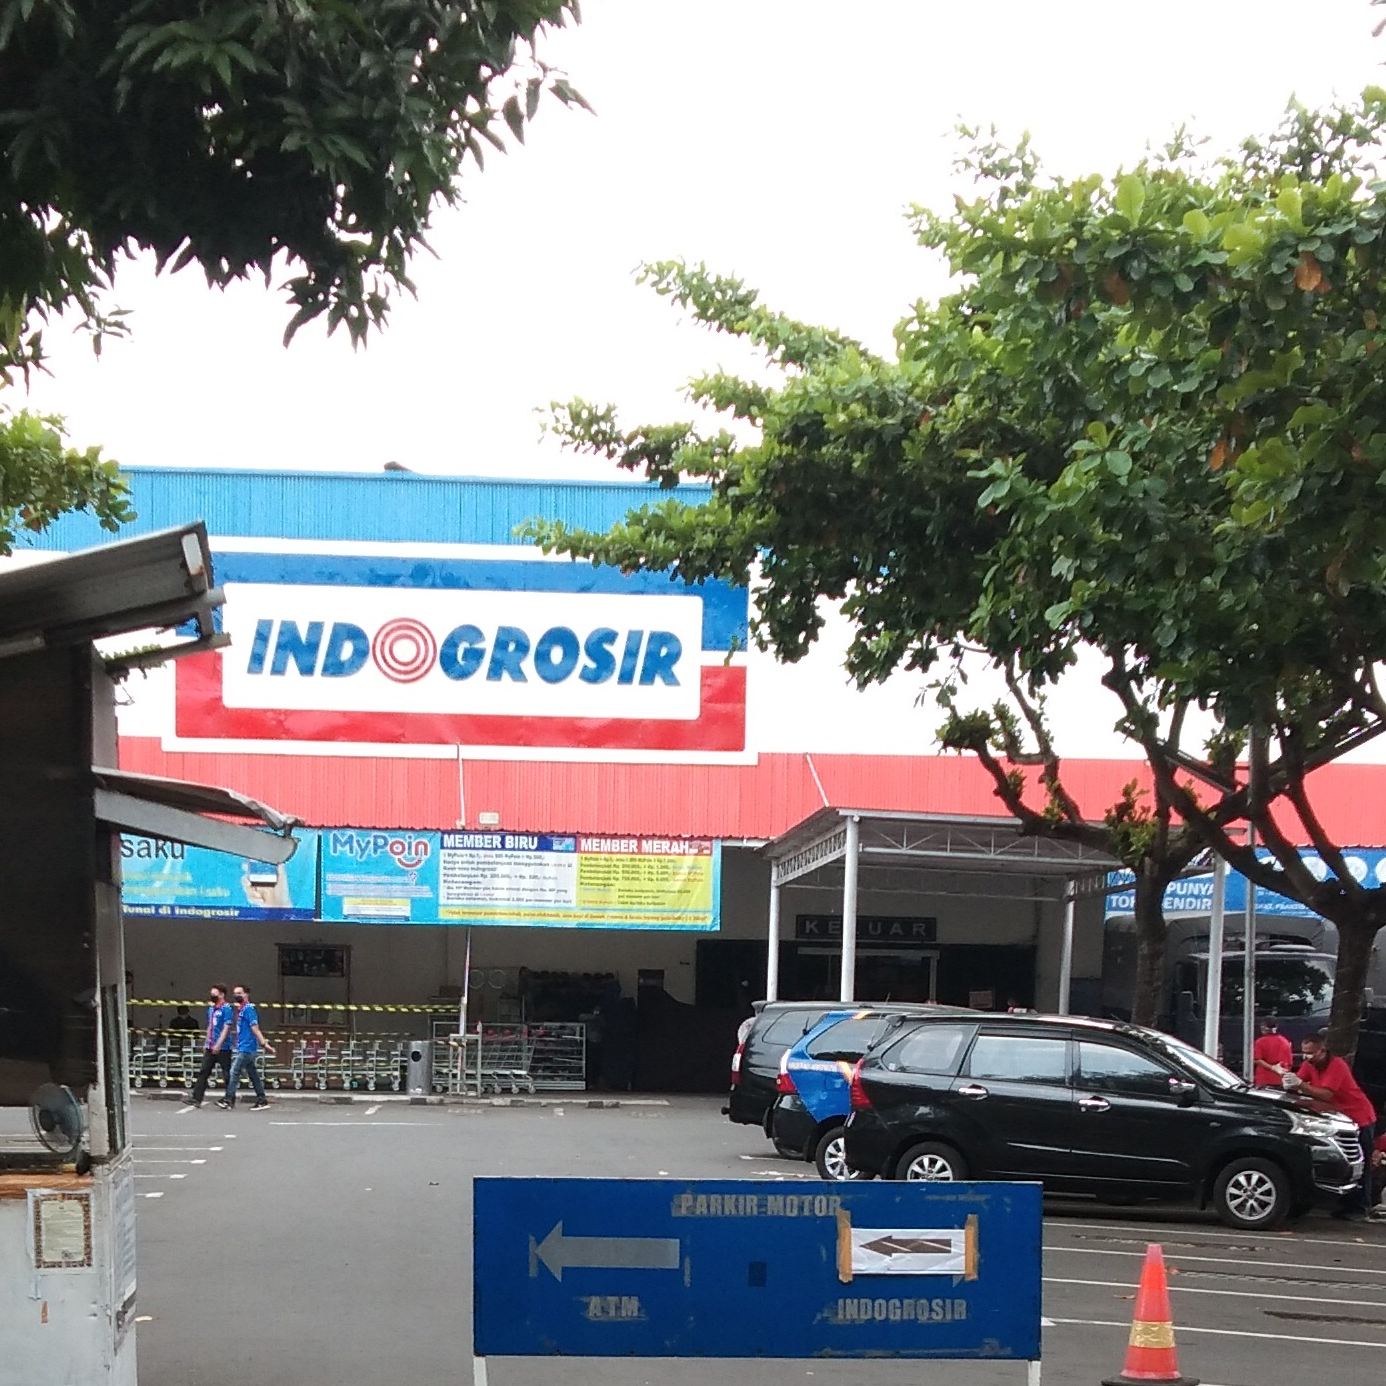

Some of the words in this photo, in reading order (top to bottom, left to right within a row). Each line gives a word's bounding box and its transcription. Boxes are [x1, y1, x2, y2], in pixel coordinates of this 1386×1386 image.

[246, 617, 682, 687] INDOGROSIR
[443, 833, 503, 849] MEMBER
[504, 835, 538, 850] BIRU
[580, 838, 639, 853] MEMBER
[641, 840, 690, 854] MERAH
[805, 919, 927, 937] KEUAR
[680, 1194, 758, 1215] PARKIR
[767, 1195, 841, 1216] MOTOR
[589, 1296, 638, 1317] ATM
[837, 1298, 967, 1320] INDOGROSIR
